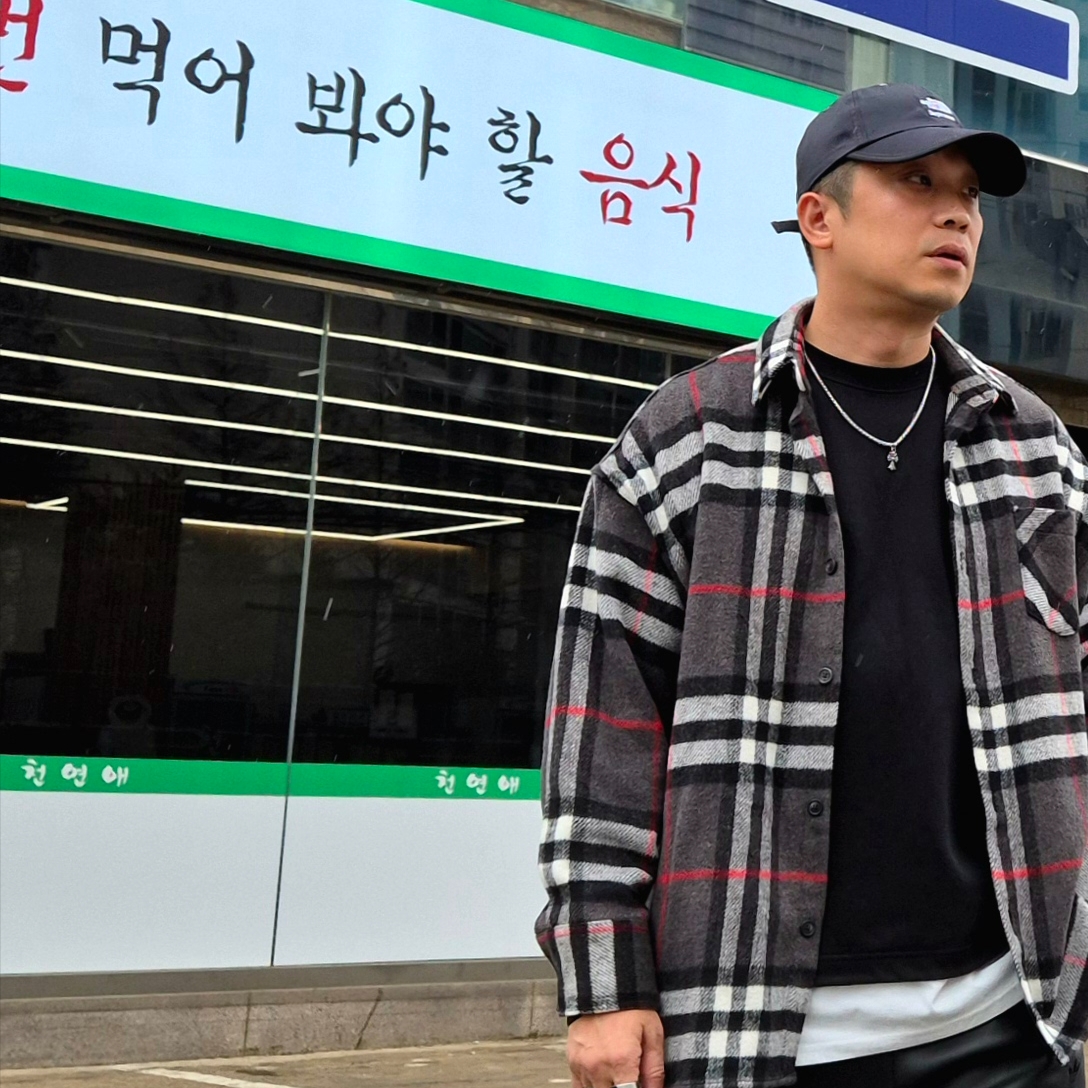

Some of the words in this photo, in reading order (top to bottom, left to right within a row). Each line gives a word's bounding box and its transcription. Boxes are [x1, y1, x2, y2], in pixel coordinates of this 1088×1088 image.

[100, 17, 256, 143] 먹어
[296, 67, 450, 180] 봐야
[487, 106, 553, 205] 할
[580, 133, 702, 242] 음식
